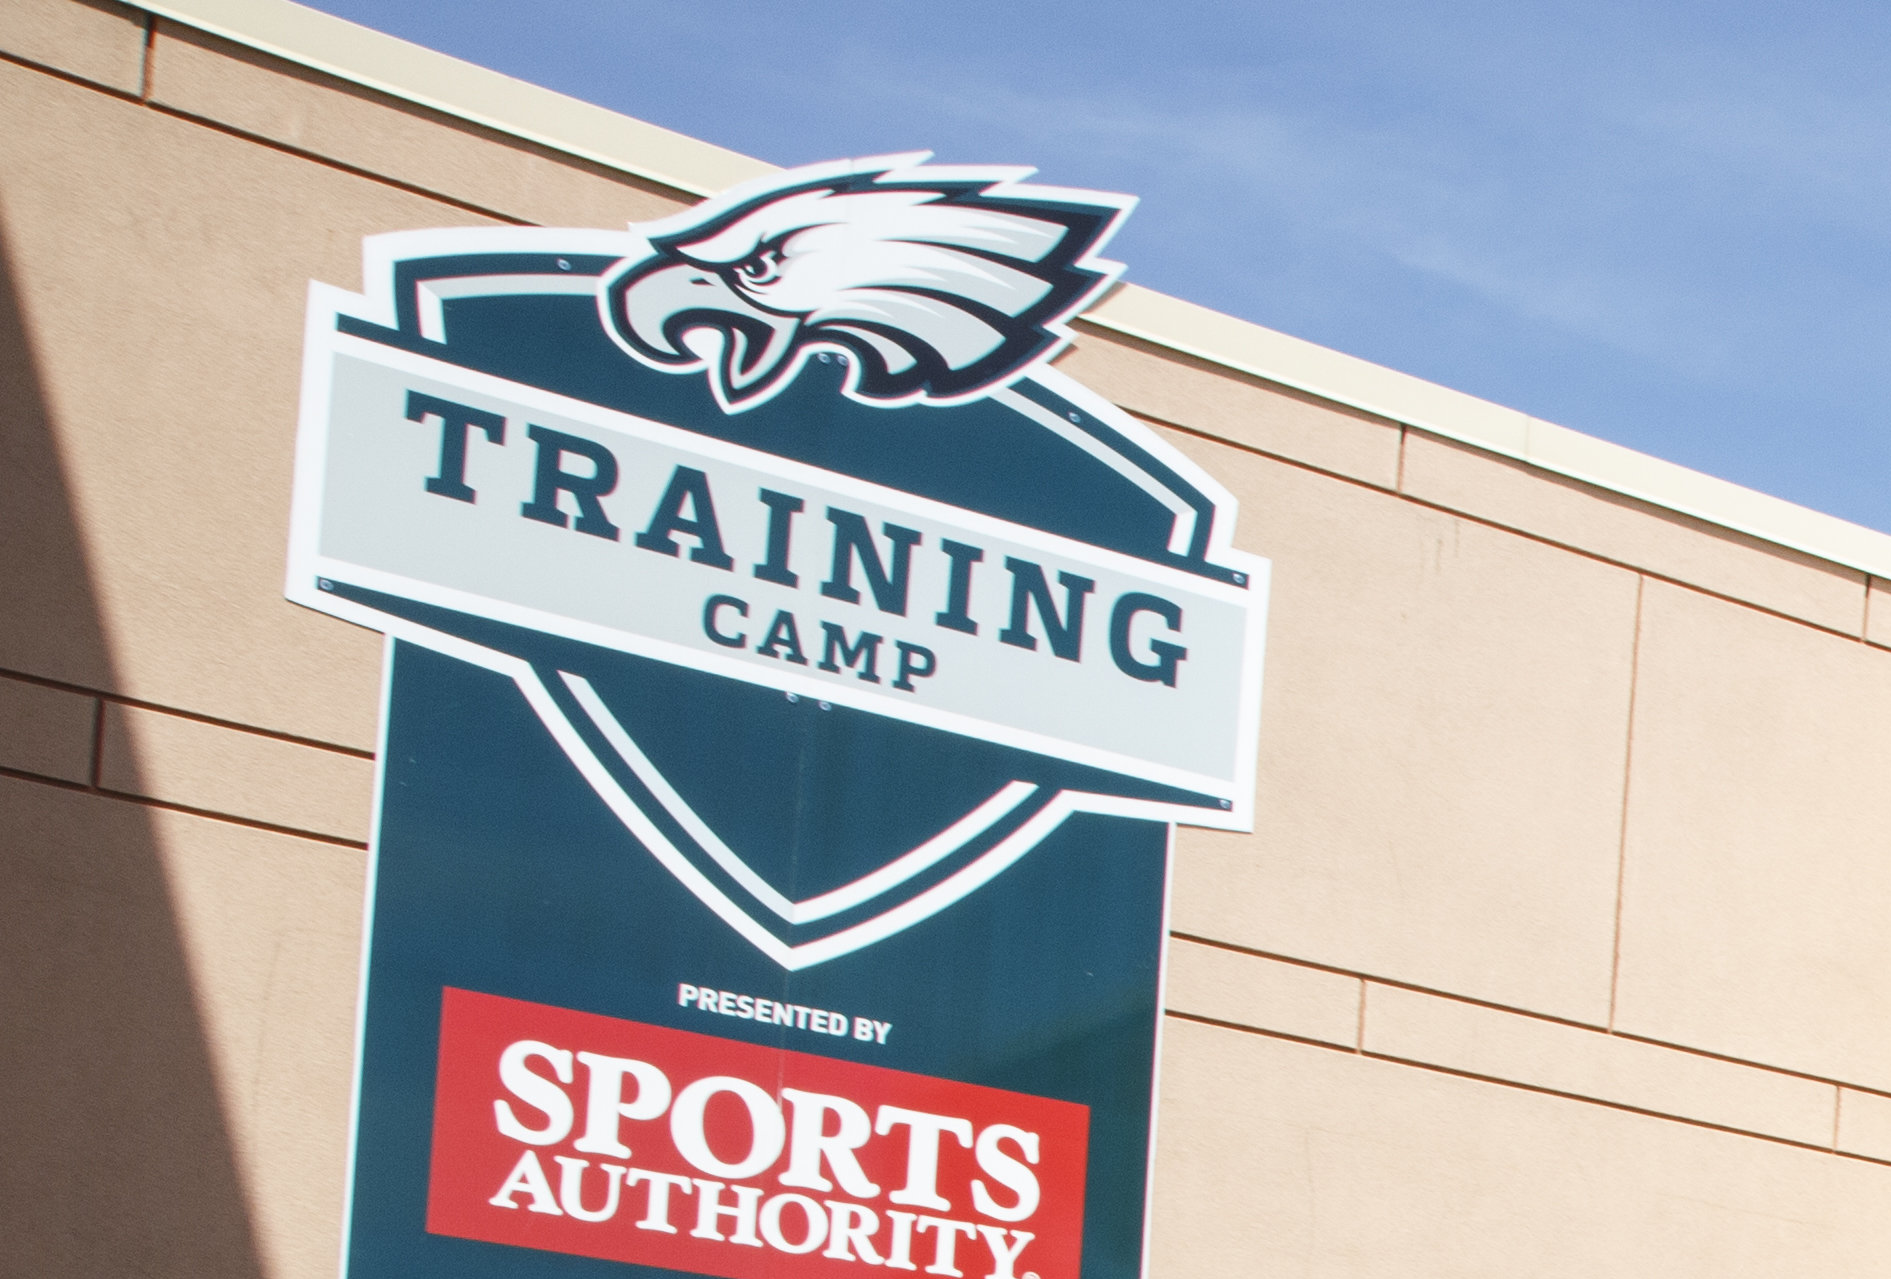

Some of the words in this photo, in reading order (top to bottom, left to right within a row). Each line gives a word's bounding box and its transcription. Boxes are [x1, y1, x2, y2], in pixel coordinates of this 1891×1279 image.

[405, 388, 1189, 689] TRAINING
[702, 592, 938, 690] CAMP
[677, 984, 848, 1038] PRESENTED
[853, 1014, 893, 1045] BY
[492, 1040, 1041, 1226] SPORTS
